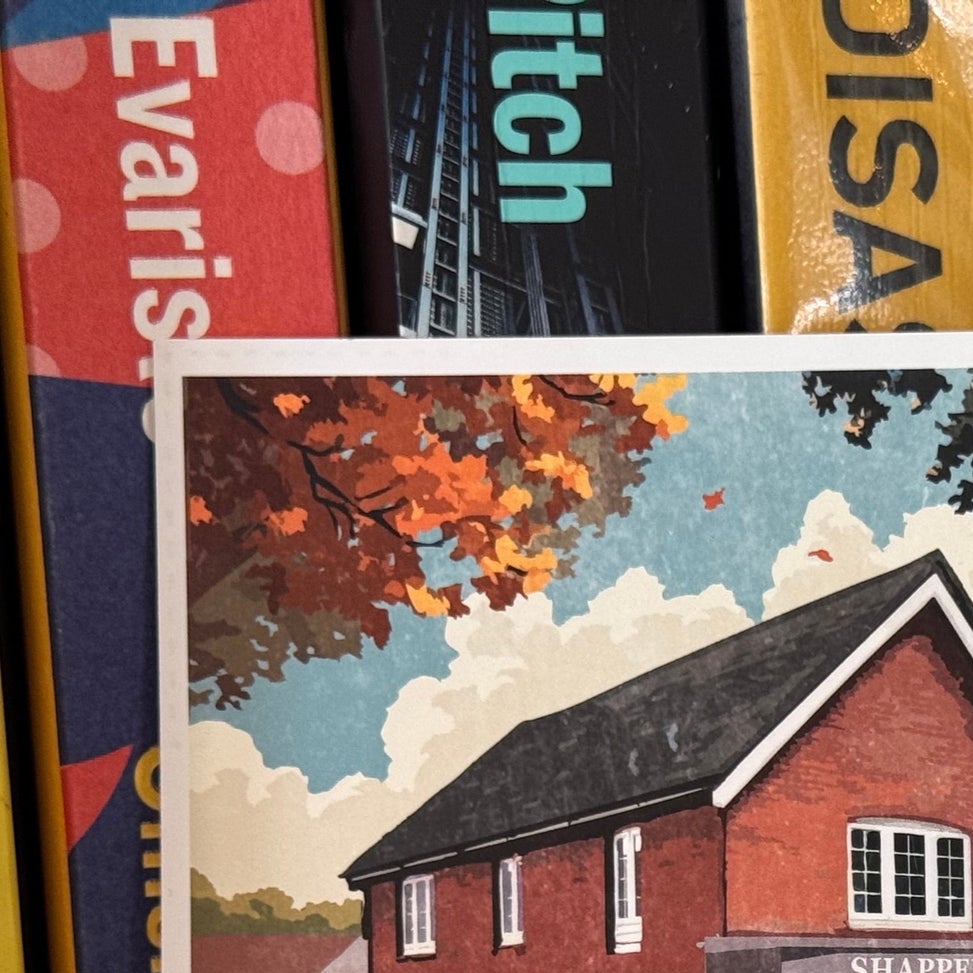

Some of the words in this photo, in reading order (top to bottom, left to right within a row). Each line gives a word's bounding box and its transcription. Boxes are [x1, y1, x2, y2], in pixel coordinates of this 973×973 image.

[109, 16, 234, 442] Evaris
[487, 0, 613, 224] itch
[822, 0, 943, 332] DISA
